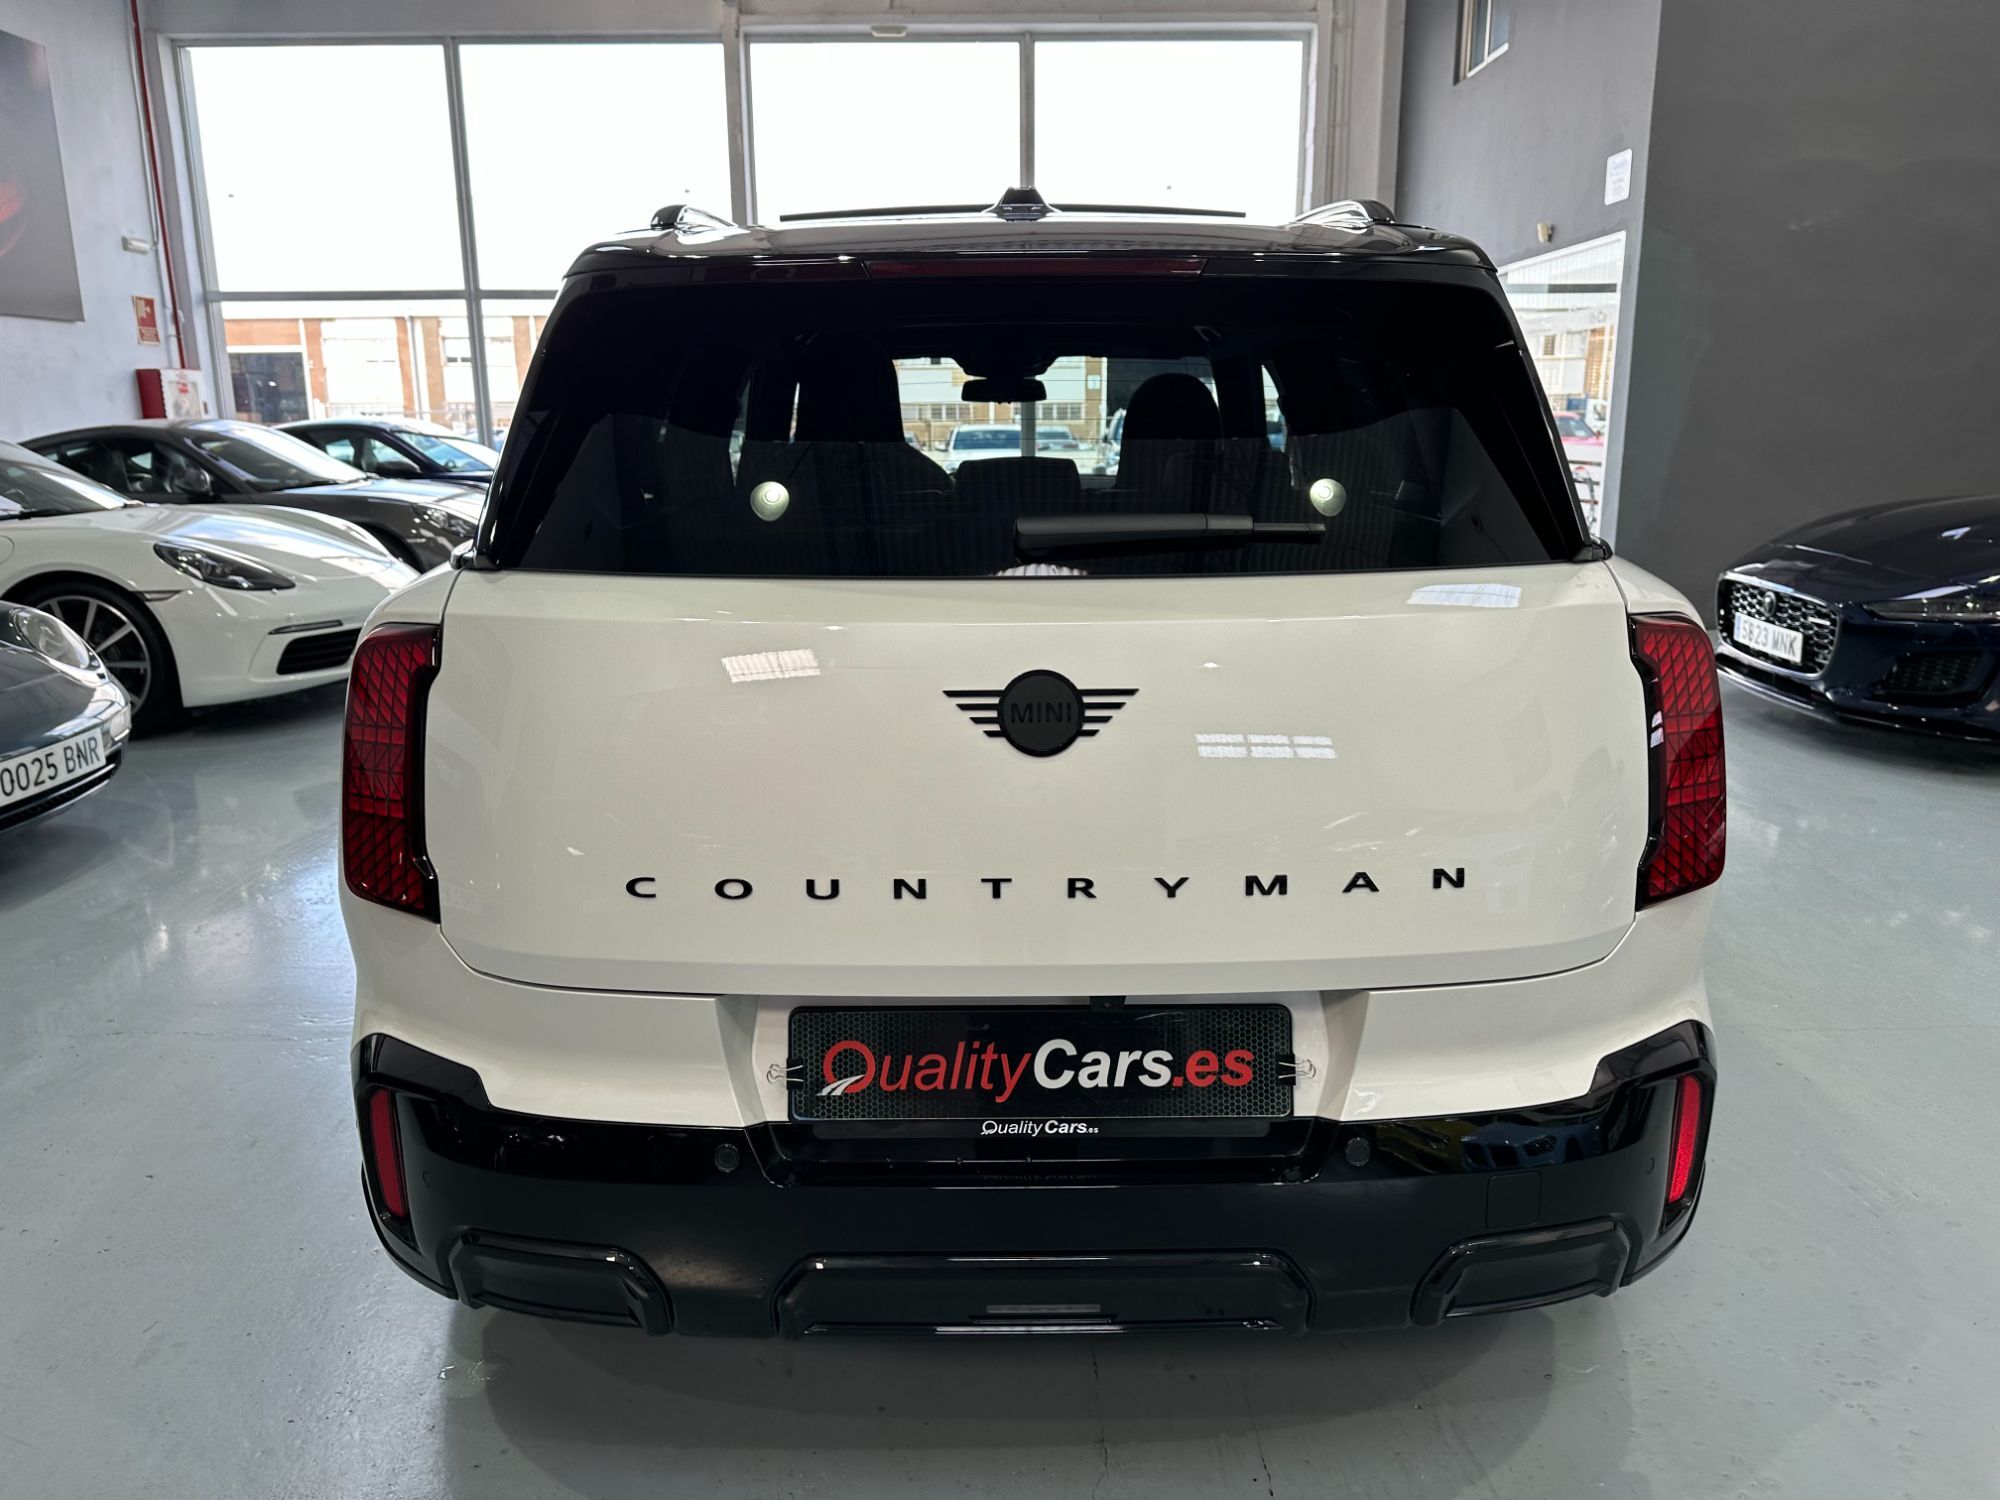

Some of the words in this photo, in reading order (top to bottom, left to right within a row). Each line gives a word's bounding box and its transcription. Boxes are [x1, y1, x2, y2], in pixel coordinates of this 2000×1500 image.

[1010, 702, 1072, 723] MINI
[0, 752, 58, 797] 0025
[63, 736, 100, 774] BNR
[625, 867, 1466, 900] COUNTRYMAN
[816, 1037, 1254, 1103] QualityCars.es
